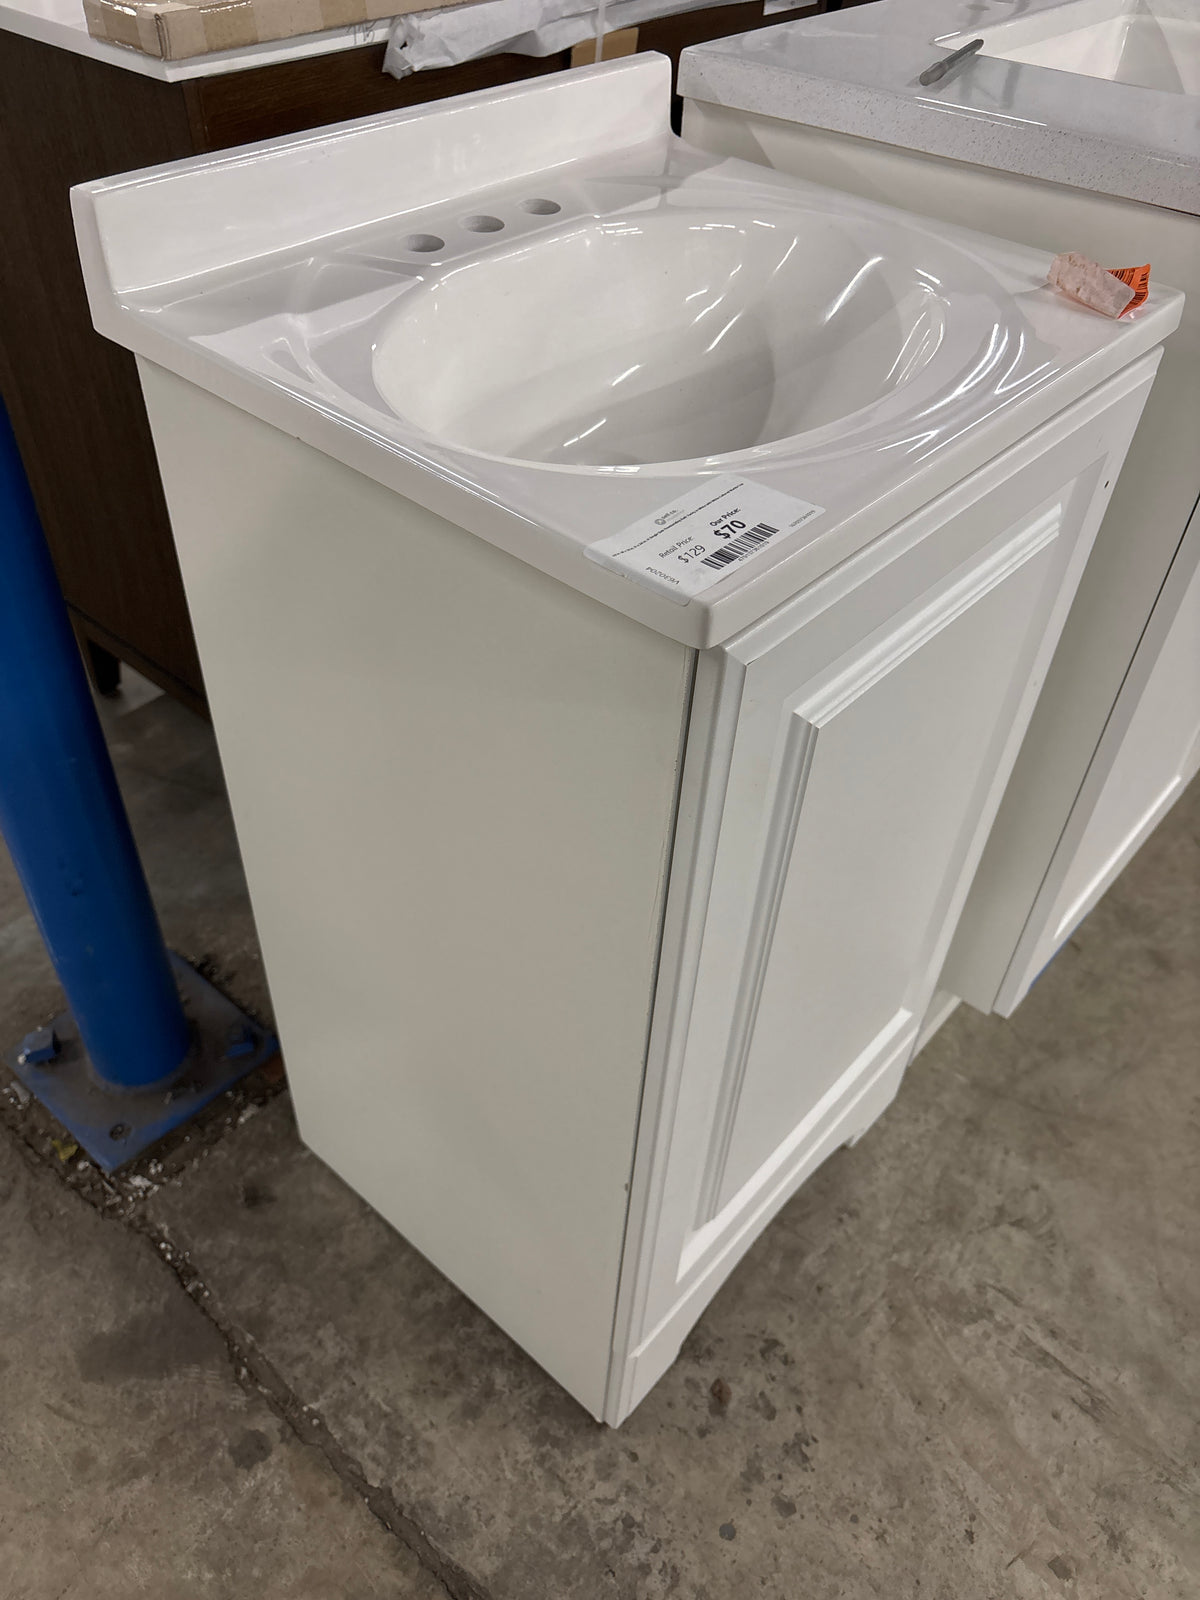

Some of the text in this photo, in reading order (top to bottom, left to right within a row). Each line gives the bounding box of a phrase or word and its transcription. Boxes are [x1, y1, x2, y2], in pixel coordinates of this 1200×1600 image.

[709, 507, 742, 527] Our Price:
[713, 520, 747, 540] $70
[658, 545, 678, 559] Retail
[677, 544, 706, 564] $129
